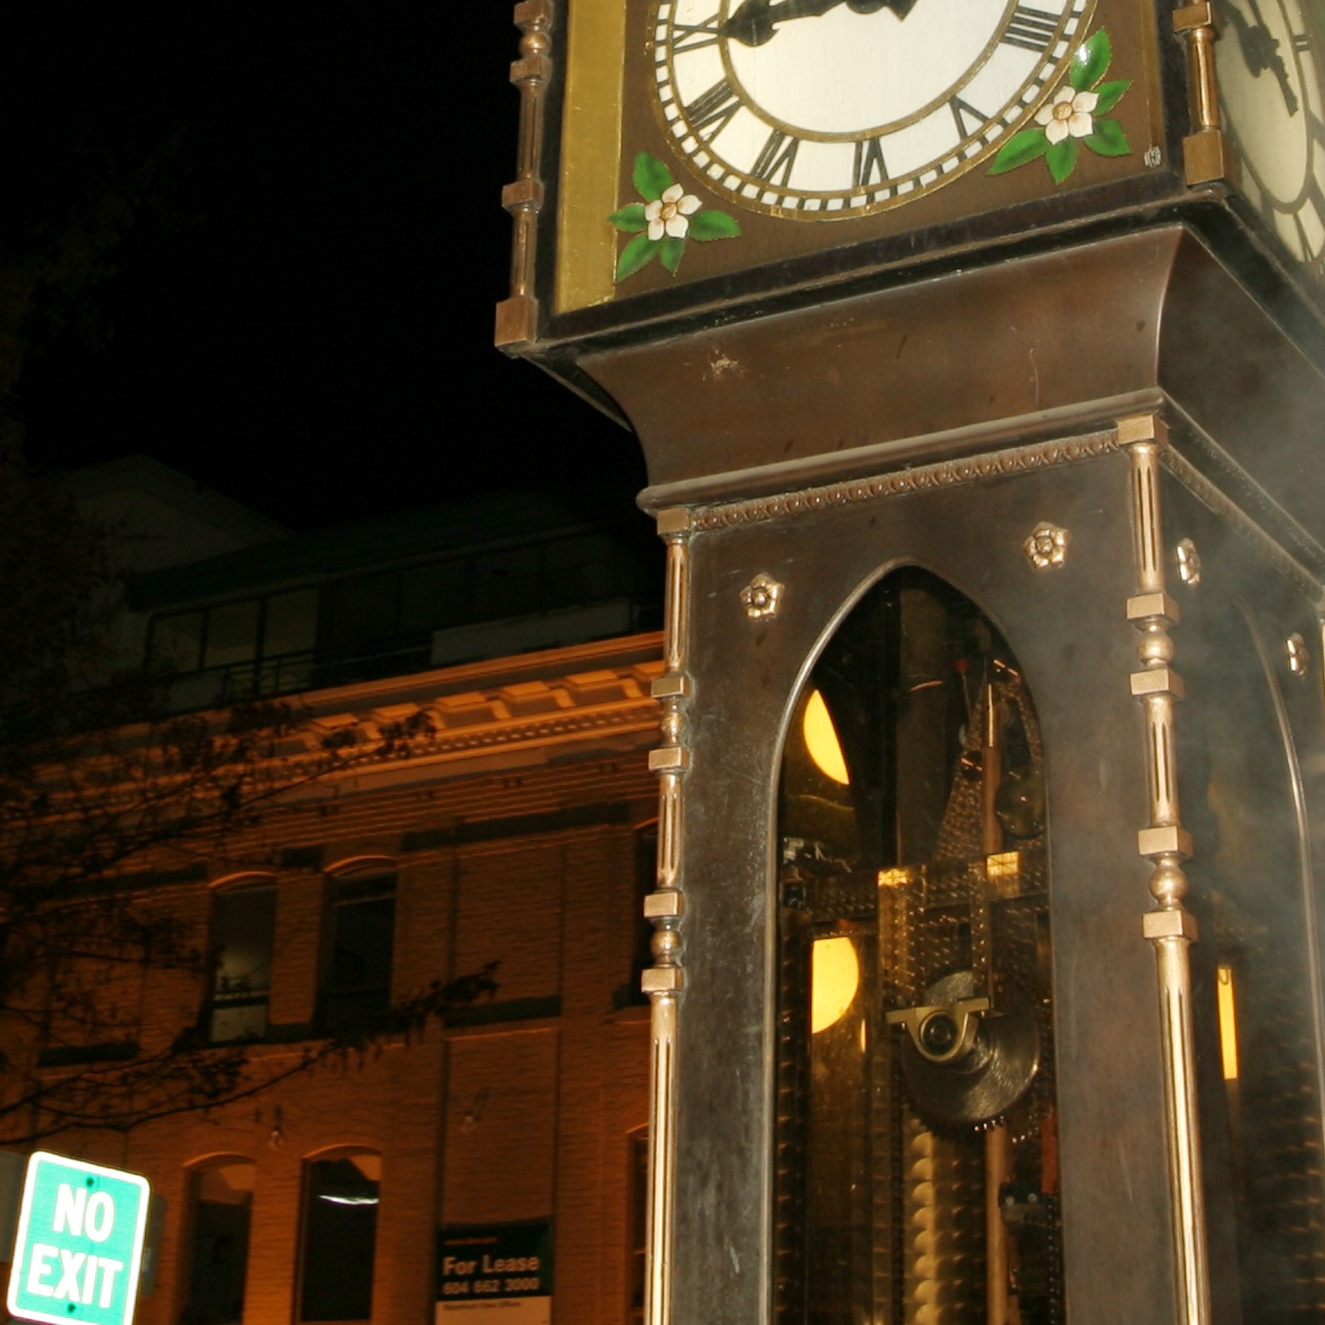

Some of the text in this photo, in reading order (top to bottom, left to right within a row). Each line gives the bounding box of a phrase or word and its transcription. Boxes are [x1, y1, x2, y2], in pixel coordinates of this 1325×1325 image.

[53, 1183, 115, 1242] NO
[27, 1243, 123, 1308] EXIT
[442, 1254, 540, 1276] For Lease
